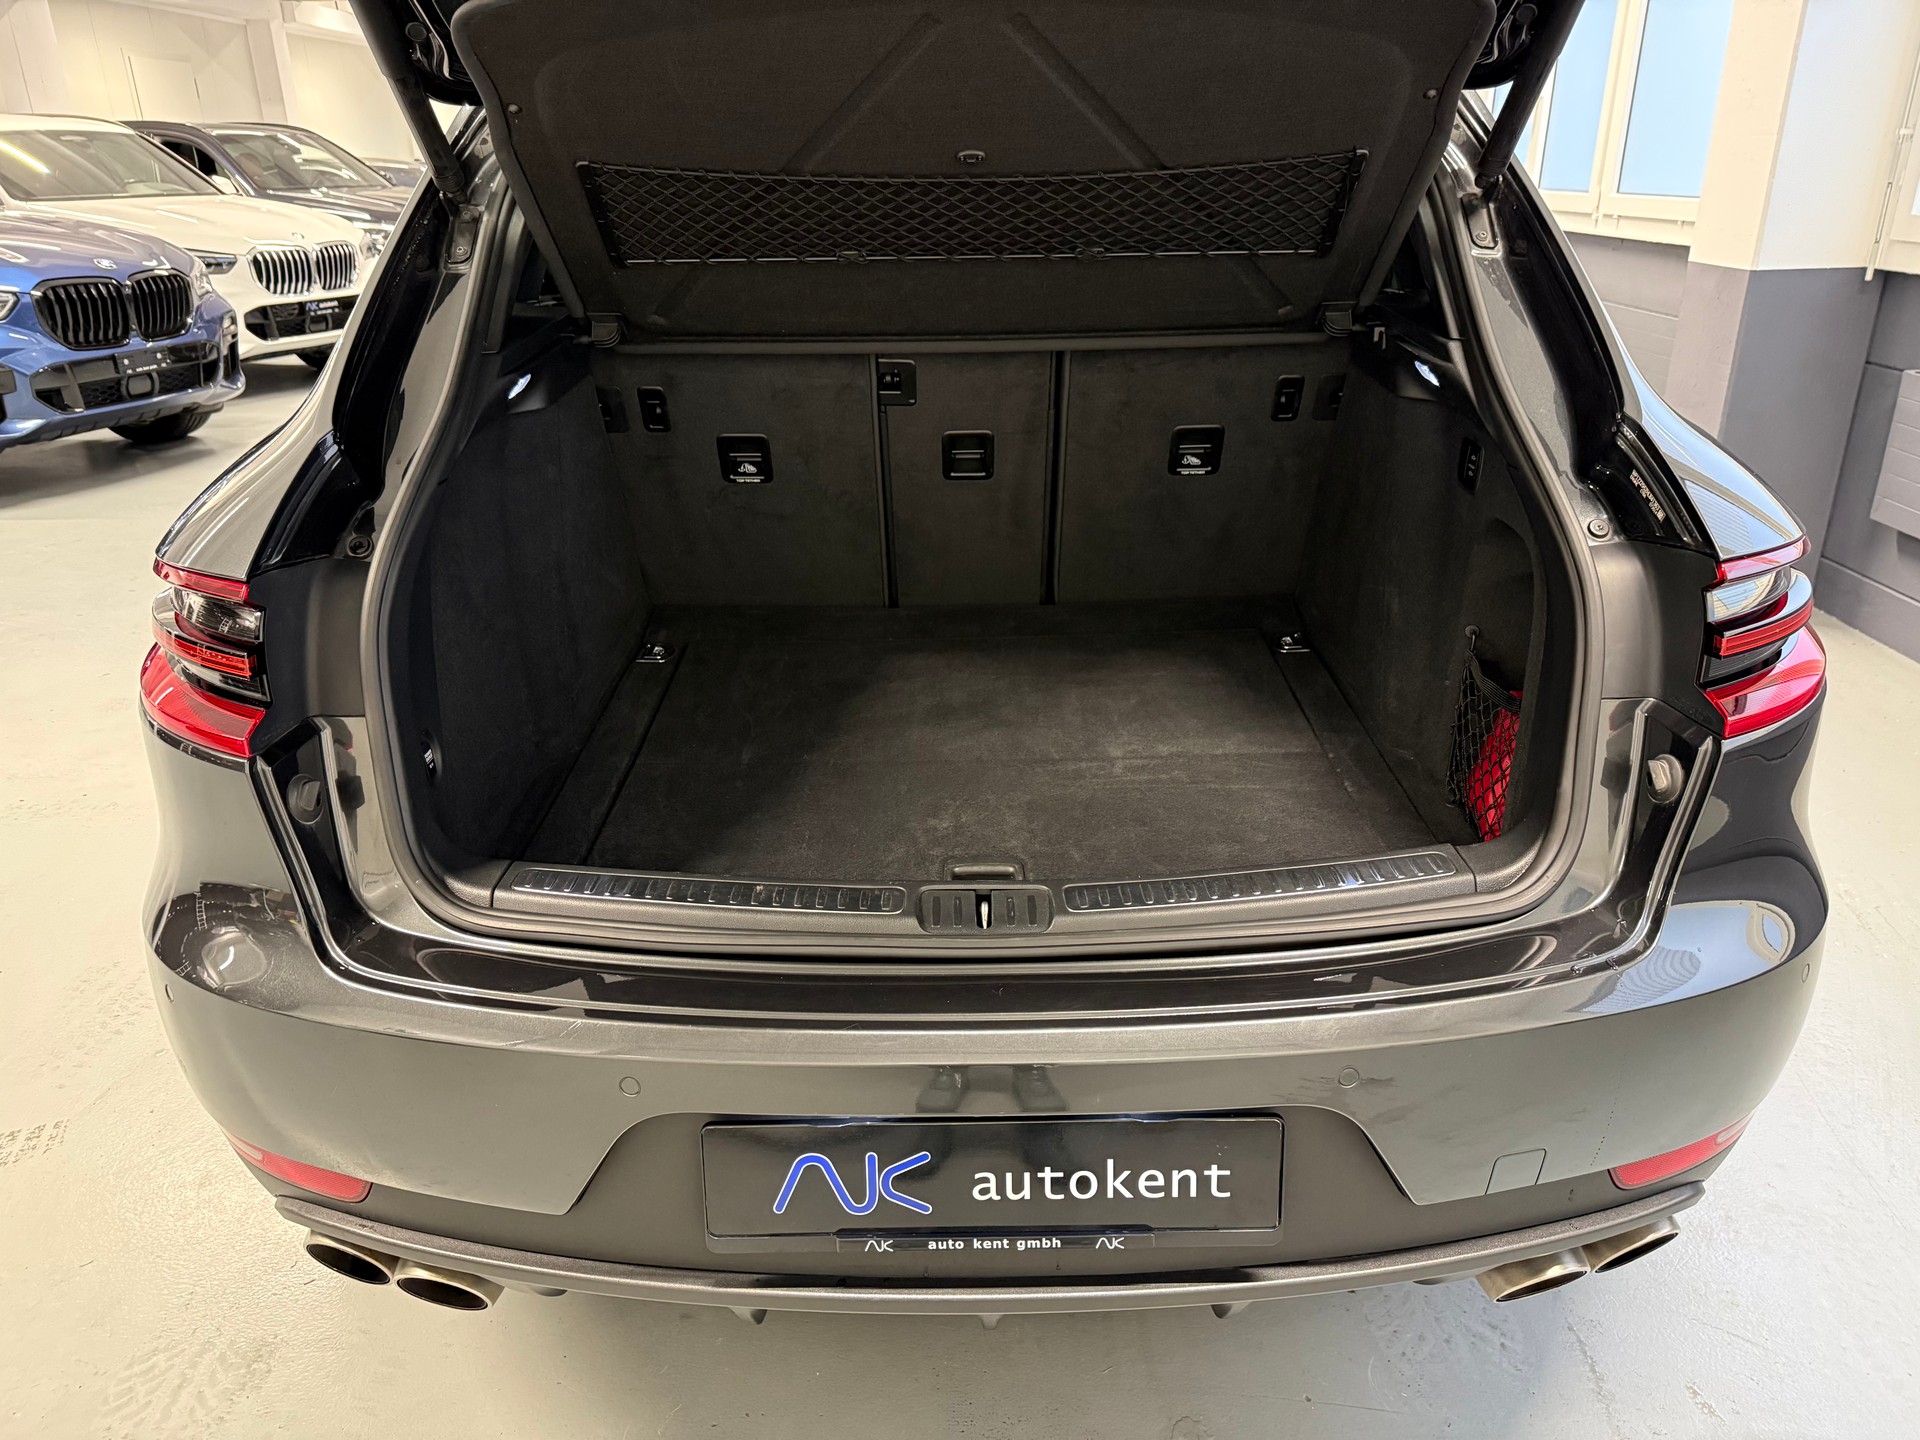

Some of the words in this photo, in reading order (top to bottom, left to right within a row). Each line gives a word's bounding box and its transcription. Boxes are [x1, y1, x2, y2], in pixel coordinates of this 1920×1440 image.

[972, 1153, 1231, 1201] autokent
[928, 1239, 964, 1250] auto
[974, 1238, 1010, 1250] kent
[1017, 1238, 1062, 1251] gmbh
